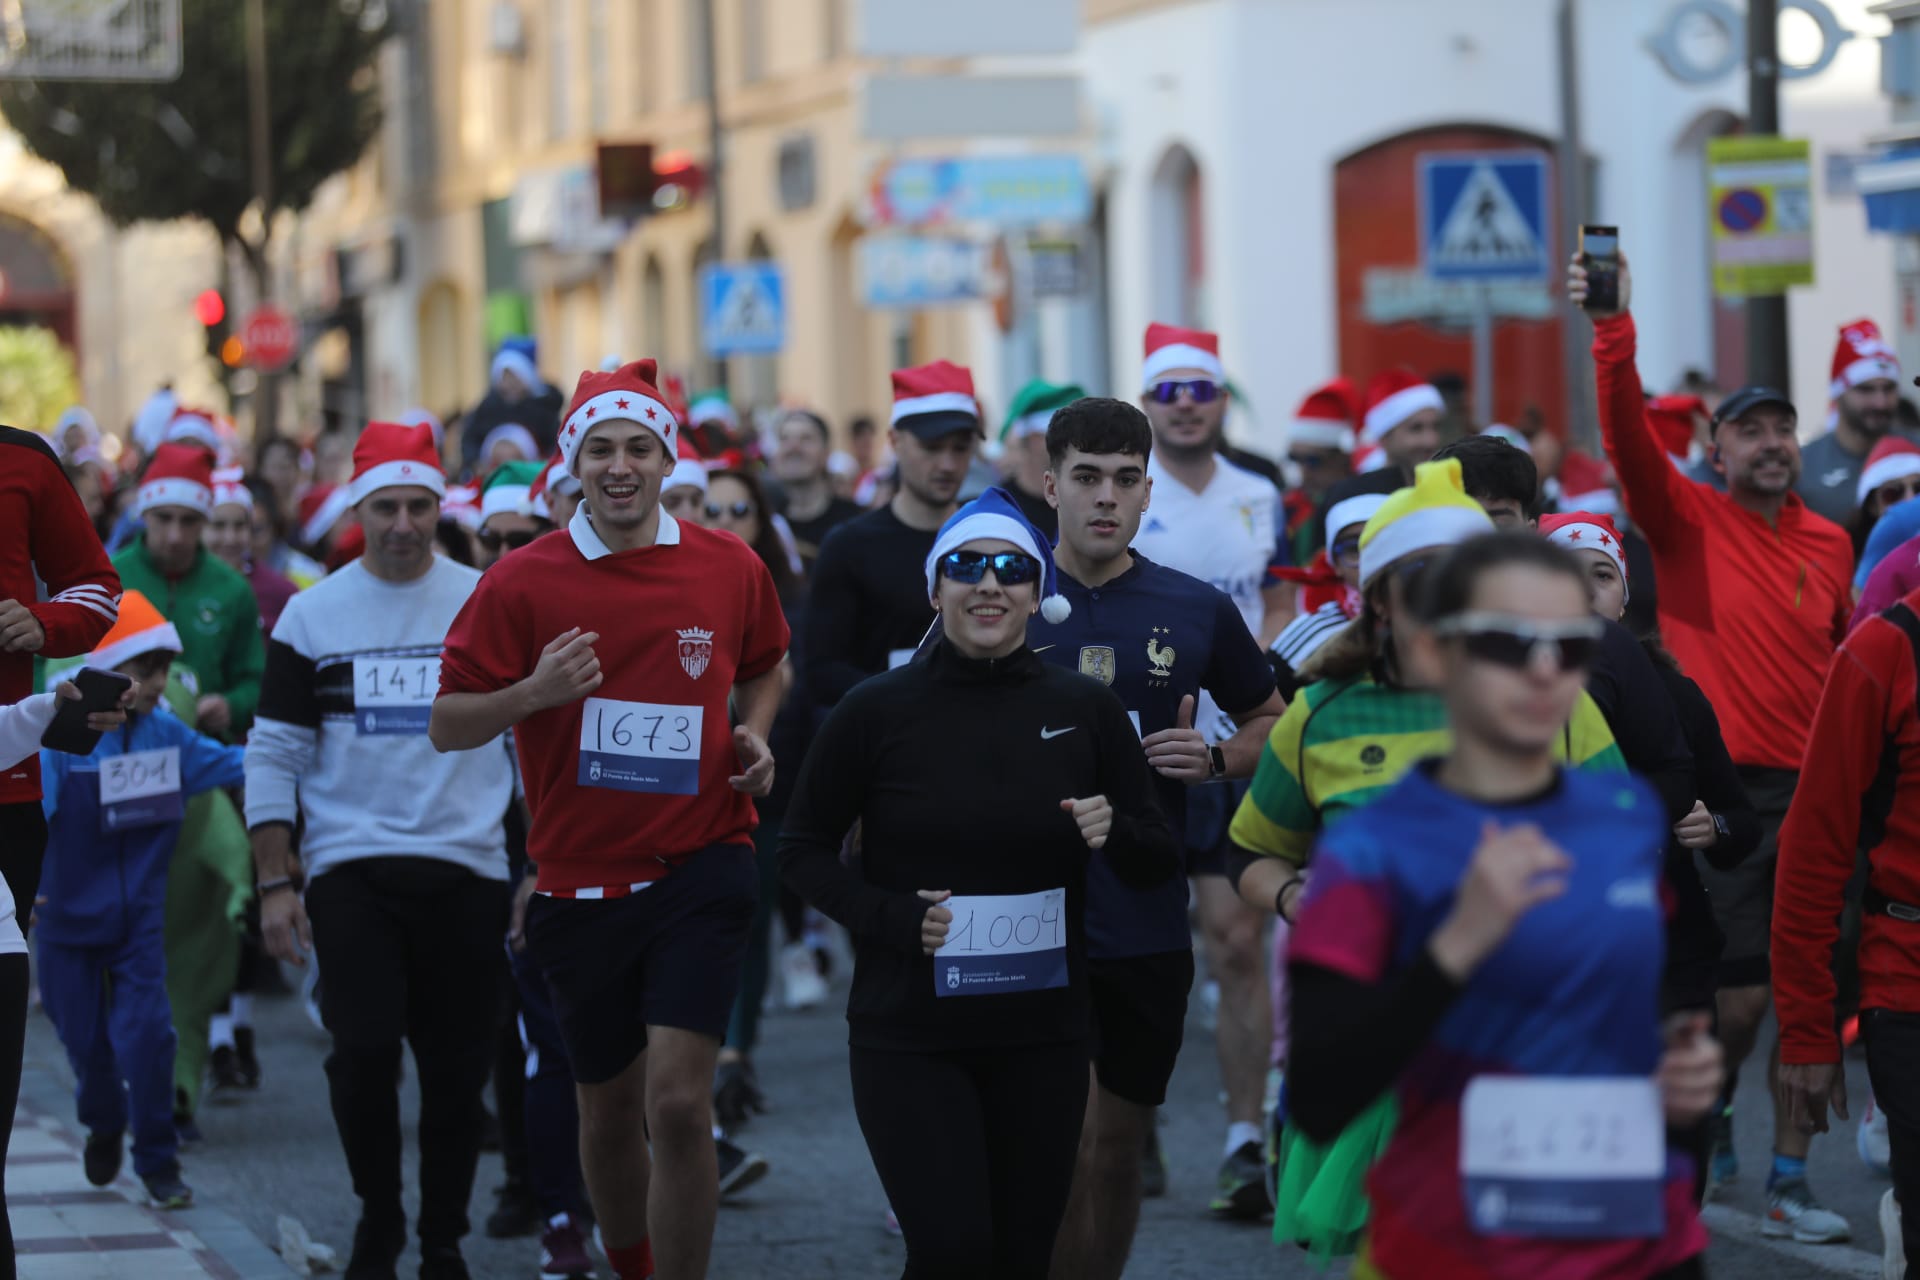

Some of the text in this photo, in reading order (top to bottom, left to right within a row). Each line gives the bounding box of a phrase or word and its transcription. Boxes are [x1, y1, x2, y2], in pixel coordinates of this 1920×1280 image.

[597, 707, 691, 752] 1673
[109, 756, 169, 794] 301
[944, 907, 1059, 951] 1004
